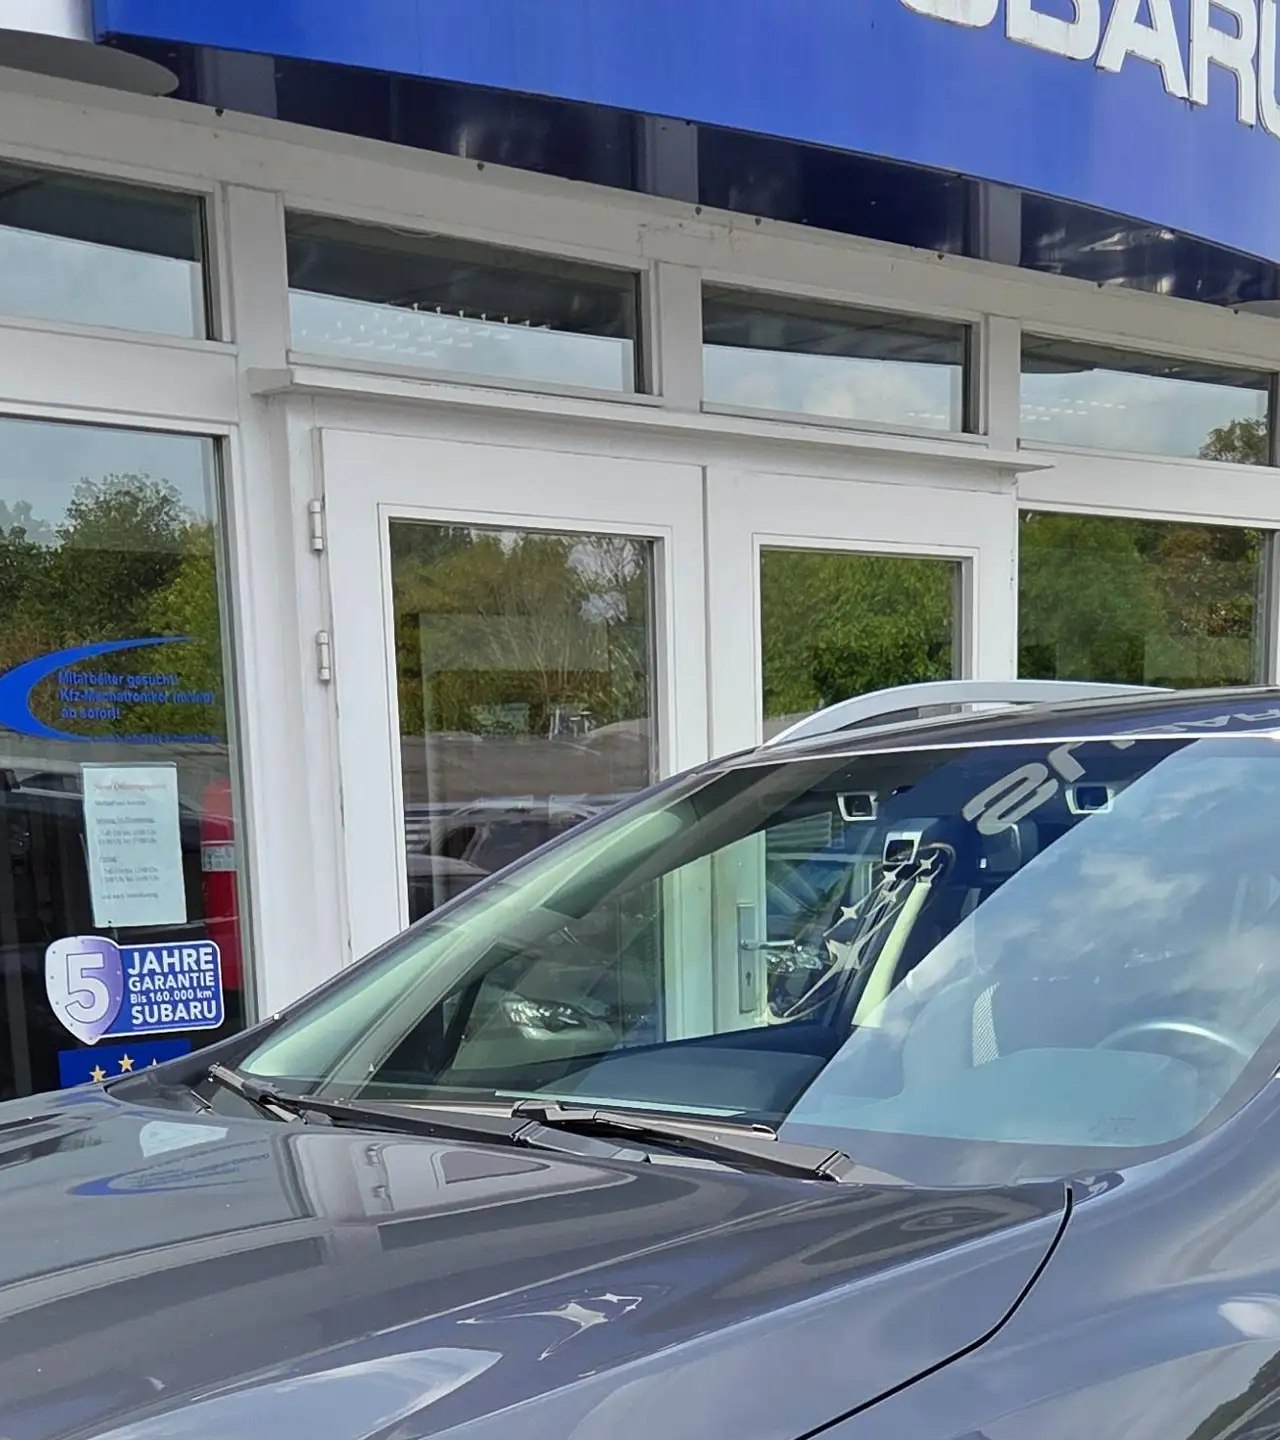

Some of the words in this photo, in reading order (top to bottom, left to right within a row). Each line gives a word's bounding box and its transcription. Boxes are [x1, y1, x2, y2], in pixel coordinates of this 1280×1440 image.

[61, 708, 77, 719] ab
[127, 946, 215, 976] JAHRE
[65, 951, 110, 1025] 5
[127, 971, 216, 992] GARANTIE
[130, 993, 147, 1005] Bis
[148, 988, 194, 1003] 160.000
[131, 1000, 217, 1025] SUBARU
